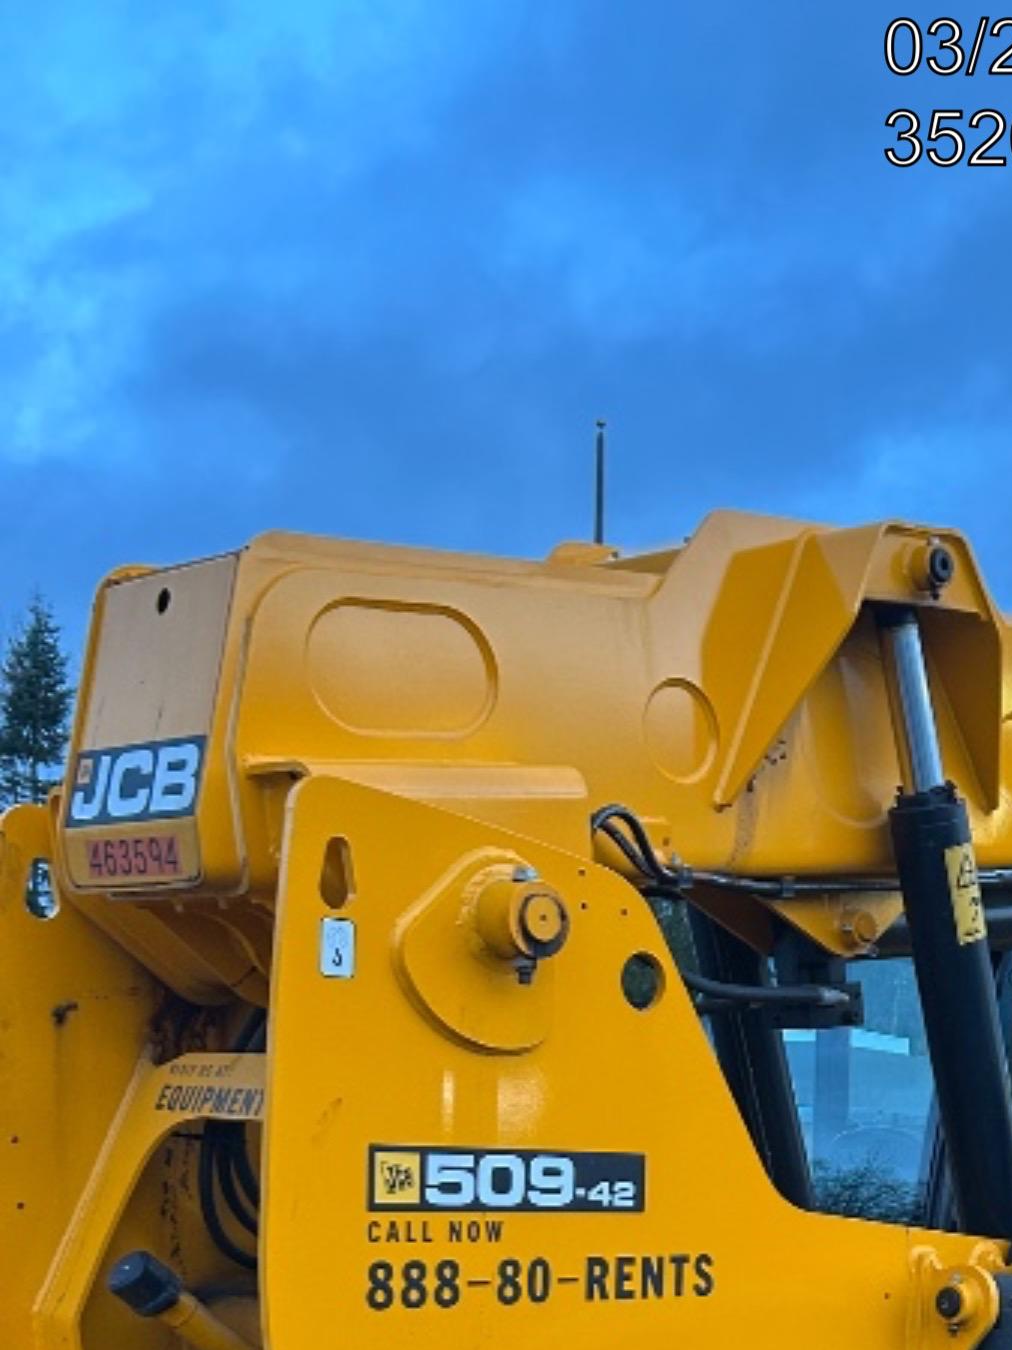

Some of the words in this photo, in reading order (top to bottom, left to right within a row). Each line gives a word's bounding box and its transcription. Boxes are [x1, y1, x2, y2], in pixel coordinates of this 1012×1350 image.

[71, 743, 199, 820] JCB
[88, 836, 178, 877] 463594
[368, 1220, 433, 1243] CALL
[449, 1220, 505, 1243] NOW
[366, 1253, 714, 1311] 888-80-RENTS
